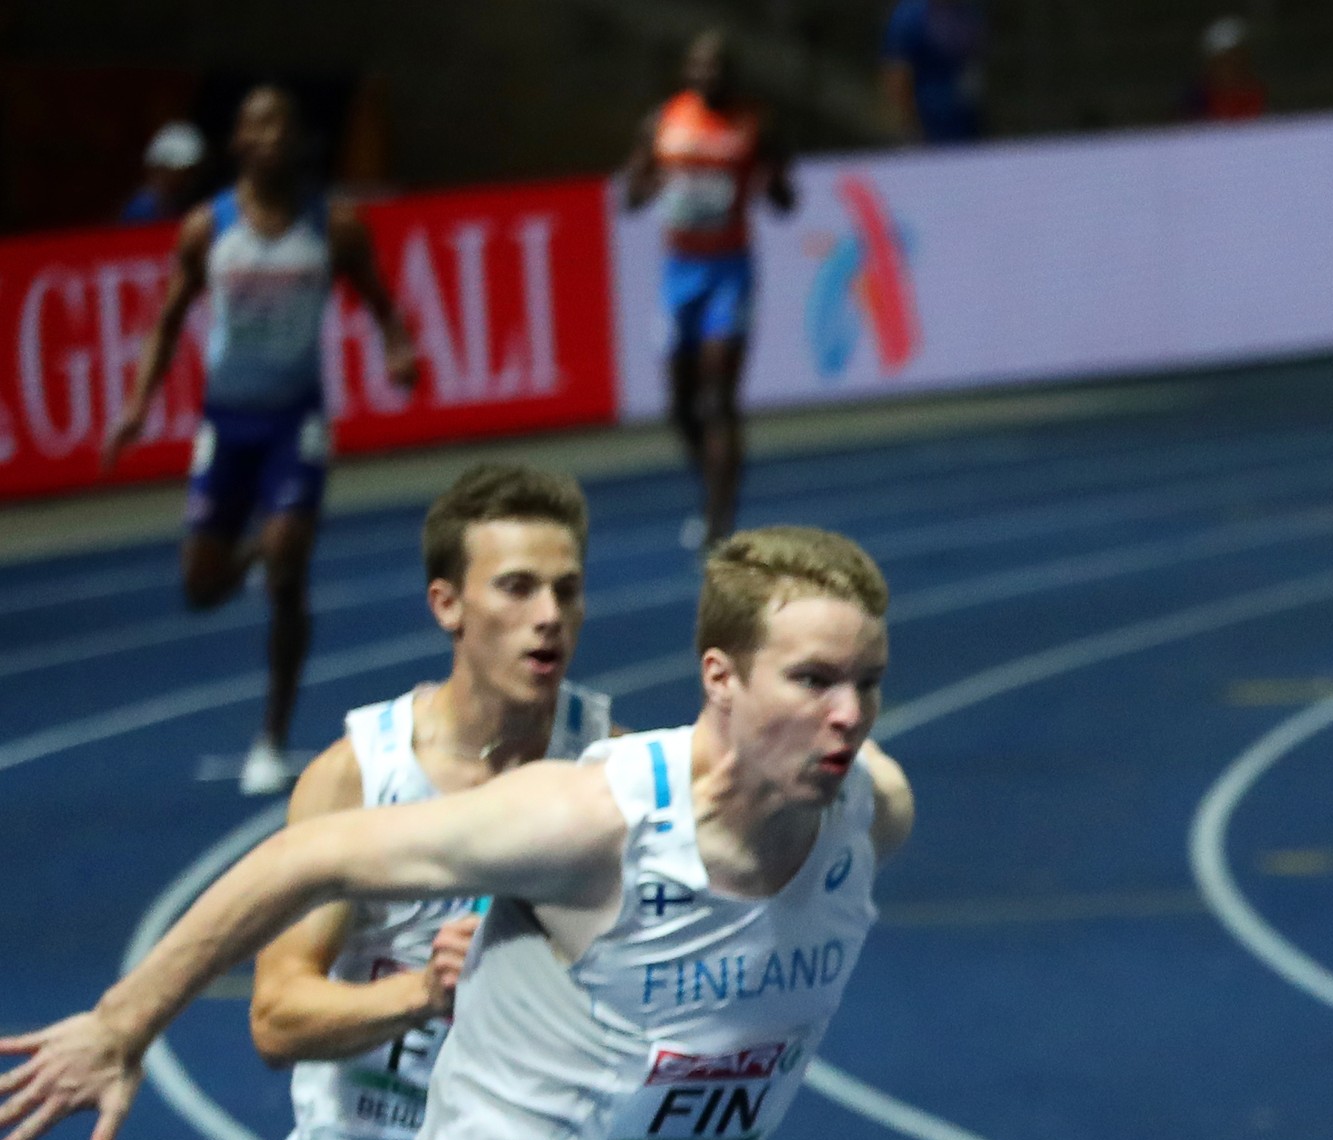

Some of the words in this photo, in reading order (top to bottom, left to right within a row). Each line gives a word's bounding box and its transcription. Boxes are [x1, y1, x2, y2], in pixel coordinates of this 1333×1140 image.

[18, 215, 566, 458] GERALI
[643, 940, 844, 1006] FINLAND
[647, 1086, 772, 1135] FIN
